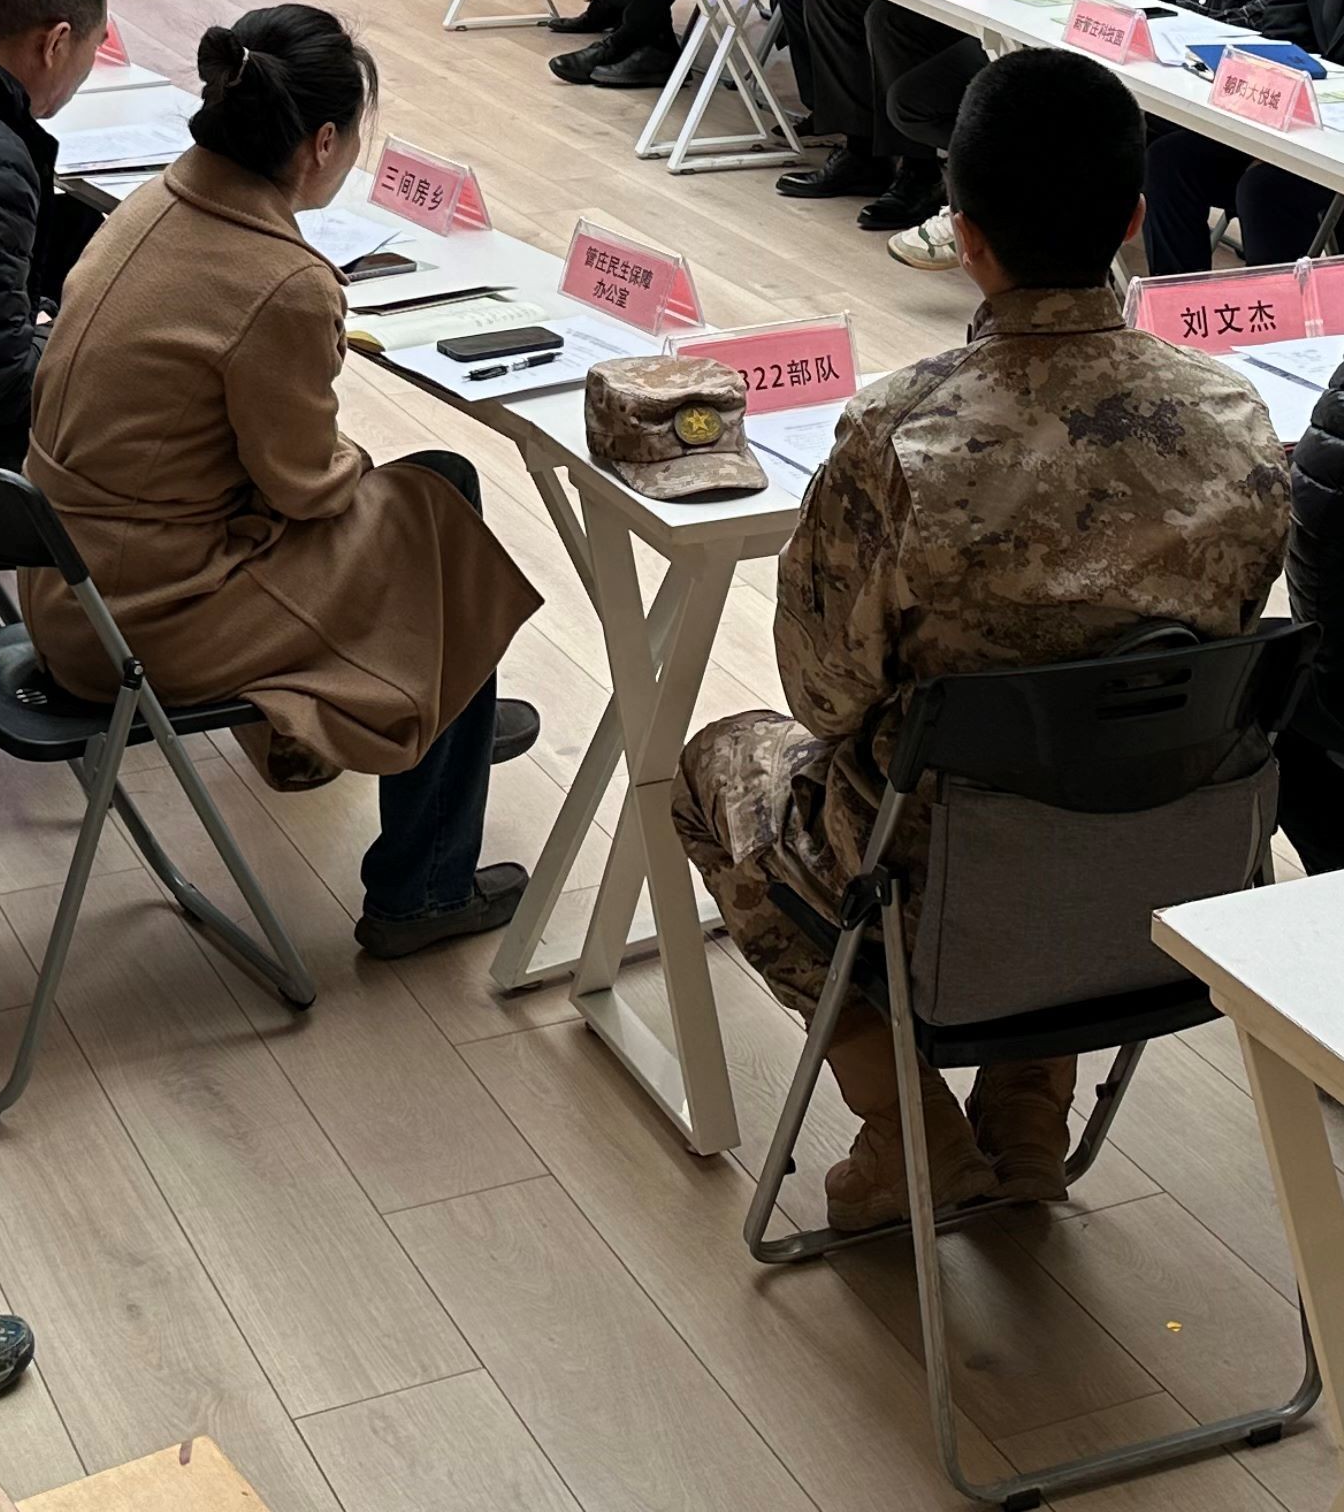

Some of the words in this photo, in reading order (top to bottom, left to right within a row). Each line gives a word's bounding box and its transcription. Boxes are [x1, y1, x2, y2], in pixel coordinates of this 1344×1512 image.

[1223, 75, 1282, 110] 朝阳大悦城
[381, 166, 444, 210] 三间房乡
[584, 246, 654, 290] 管庄民生保障
[592, 278, 630, 309] 办公室
[1180, 300, 1277, 339] 刘文杰
